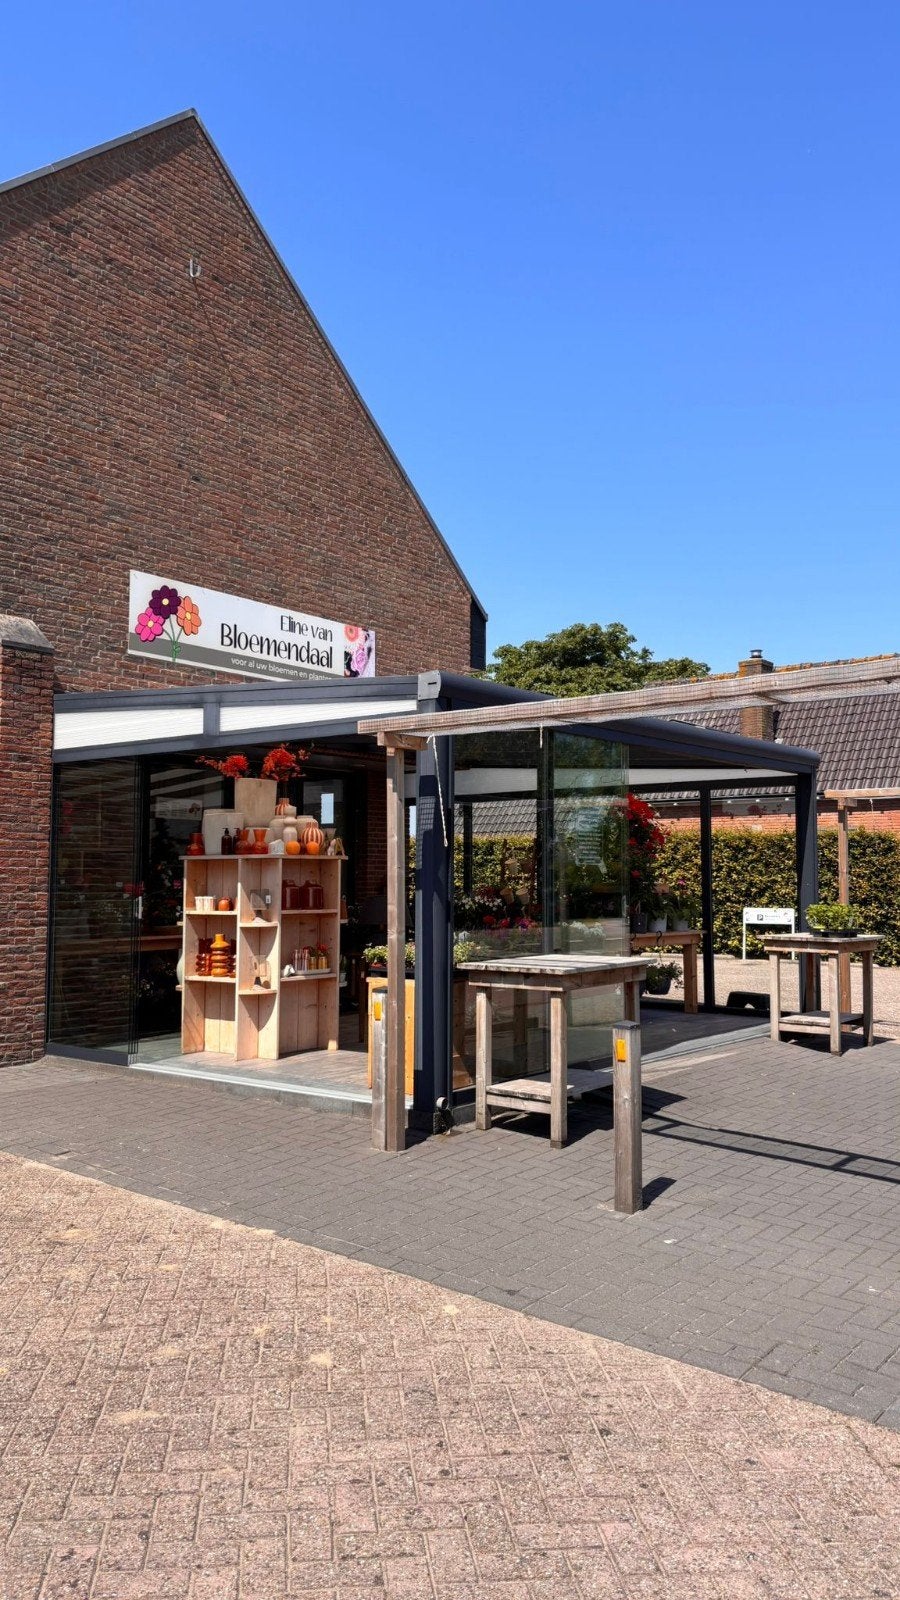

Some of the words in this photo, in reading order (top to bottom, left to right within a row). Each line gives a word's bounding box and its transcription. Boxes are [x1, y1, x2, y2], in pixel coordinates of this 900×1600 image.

[280, 615, 309, 636] Eline
[311, 625, 333, 642] van
[221, 623, 332, 669] Bloemendaal
[231, 657, 247, 666] voor
[248, 660, 255, 668] al
[256, 663, 267, 671] uw
[268, 664, 298, 676] bloemen
[309, 672, 332, 680] plante
